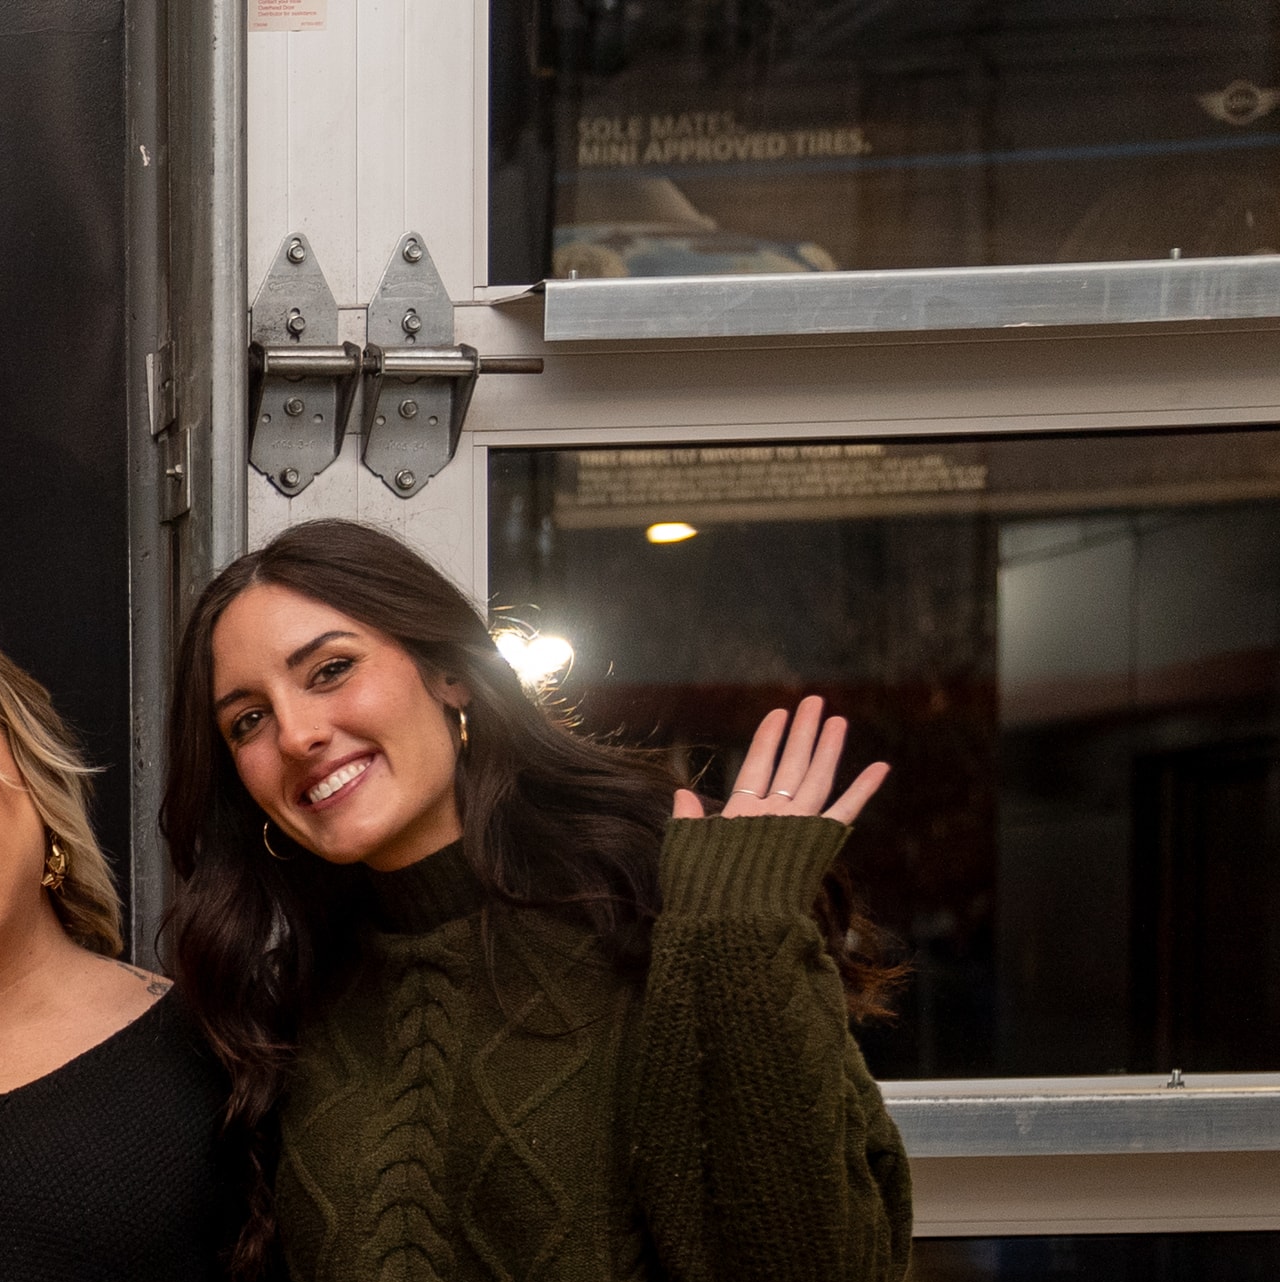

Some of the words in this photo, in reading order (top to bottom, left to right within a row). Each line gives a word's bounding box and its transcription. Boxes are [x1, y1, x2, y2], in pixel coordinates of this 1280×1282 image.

[578, 141, 639, 166] MINI
[643, 133, 786, 164] APPROVED
[795, 128, 874, 156] TIRES.
